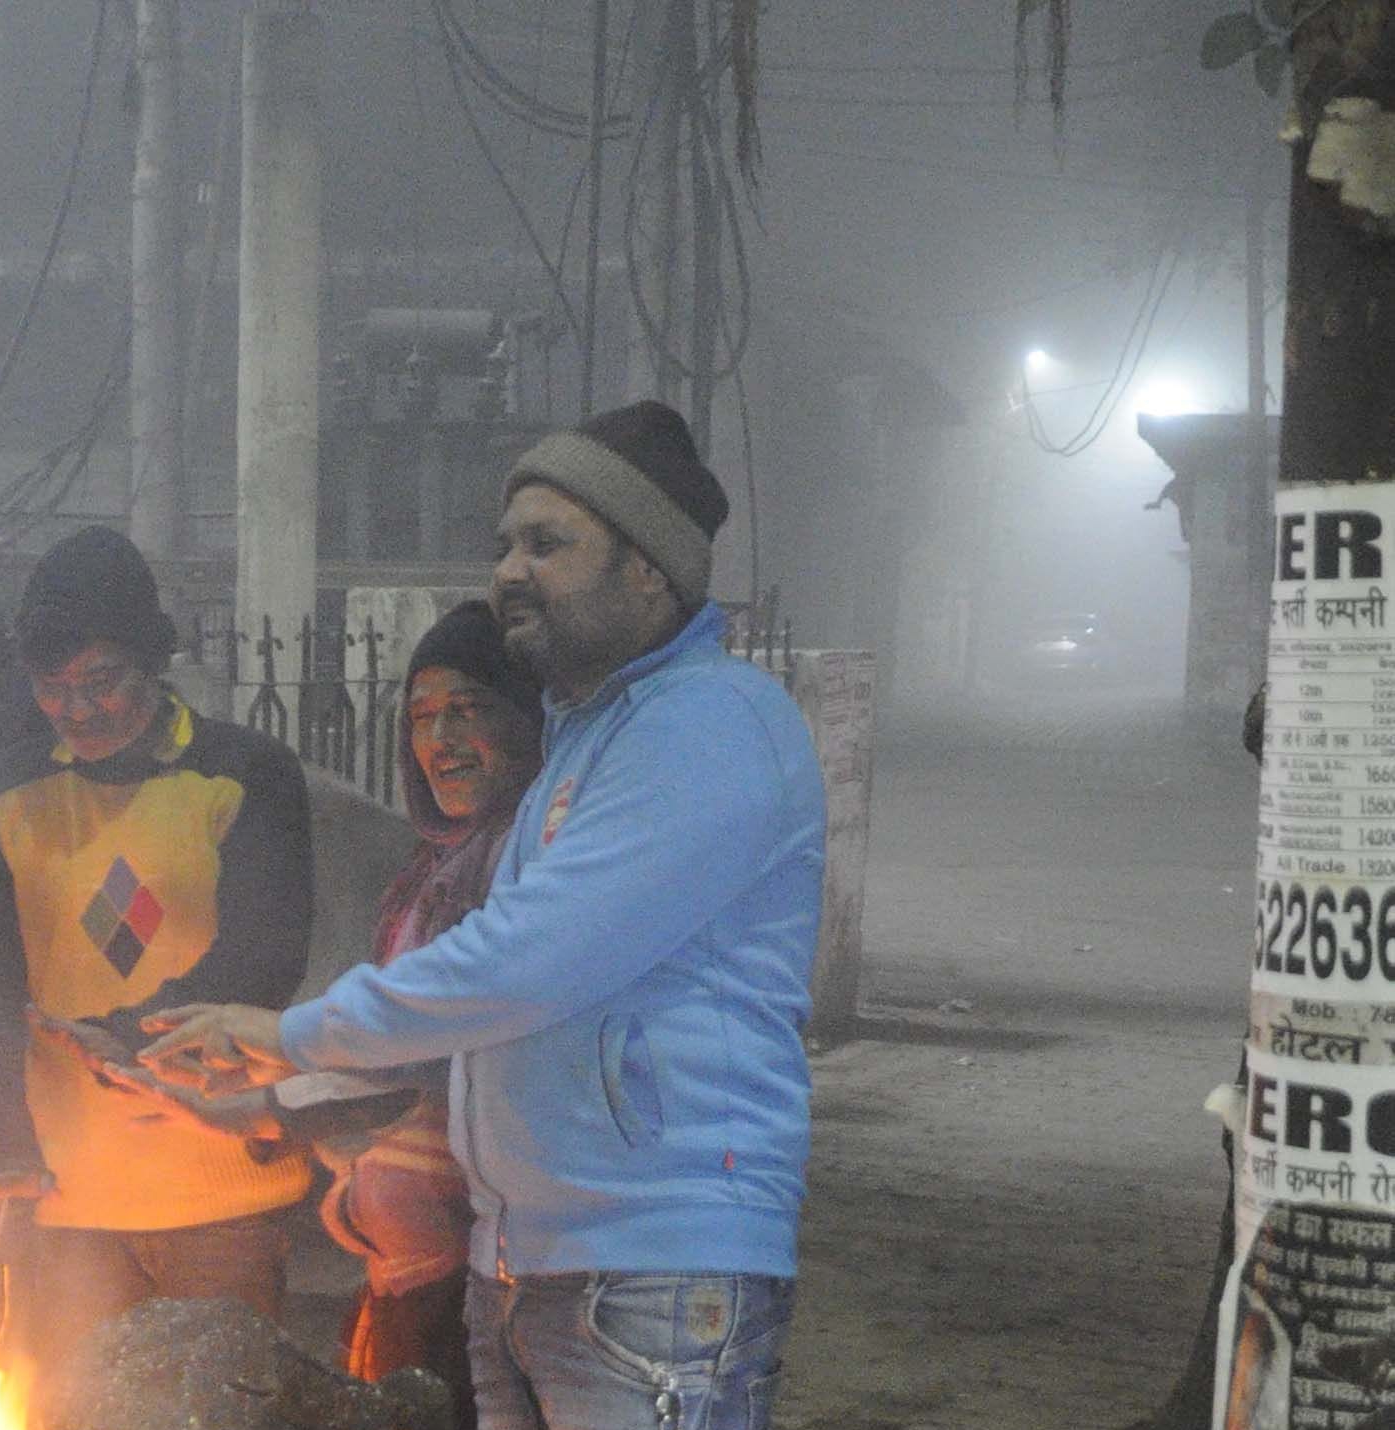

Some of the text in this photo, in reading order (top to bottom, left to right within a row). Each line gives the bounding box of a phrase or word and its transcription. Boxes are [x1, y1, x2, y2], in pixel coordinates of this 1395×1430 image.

[1273, 509, 1383, 582] ER
[1315, 585, 1389, 630] कम्पनी
[1297, 856, 1347, 874] Trade
[1269, 1011, 1370, 1065] होटल
[1285, 1160, 1357, 1202] कम्पनी
